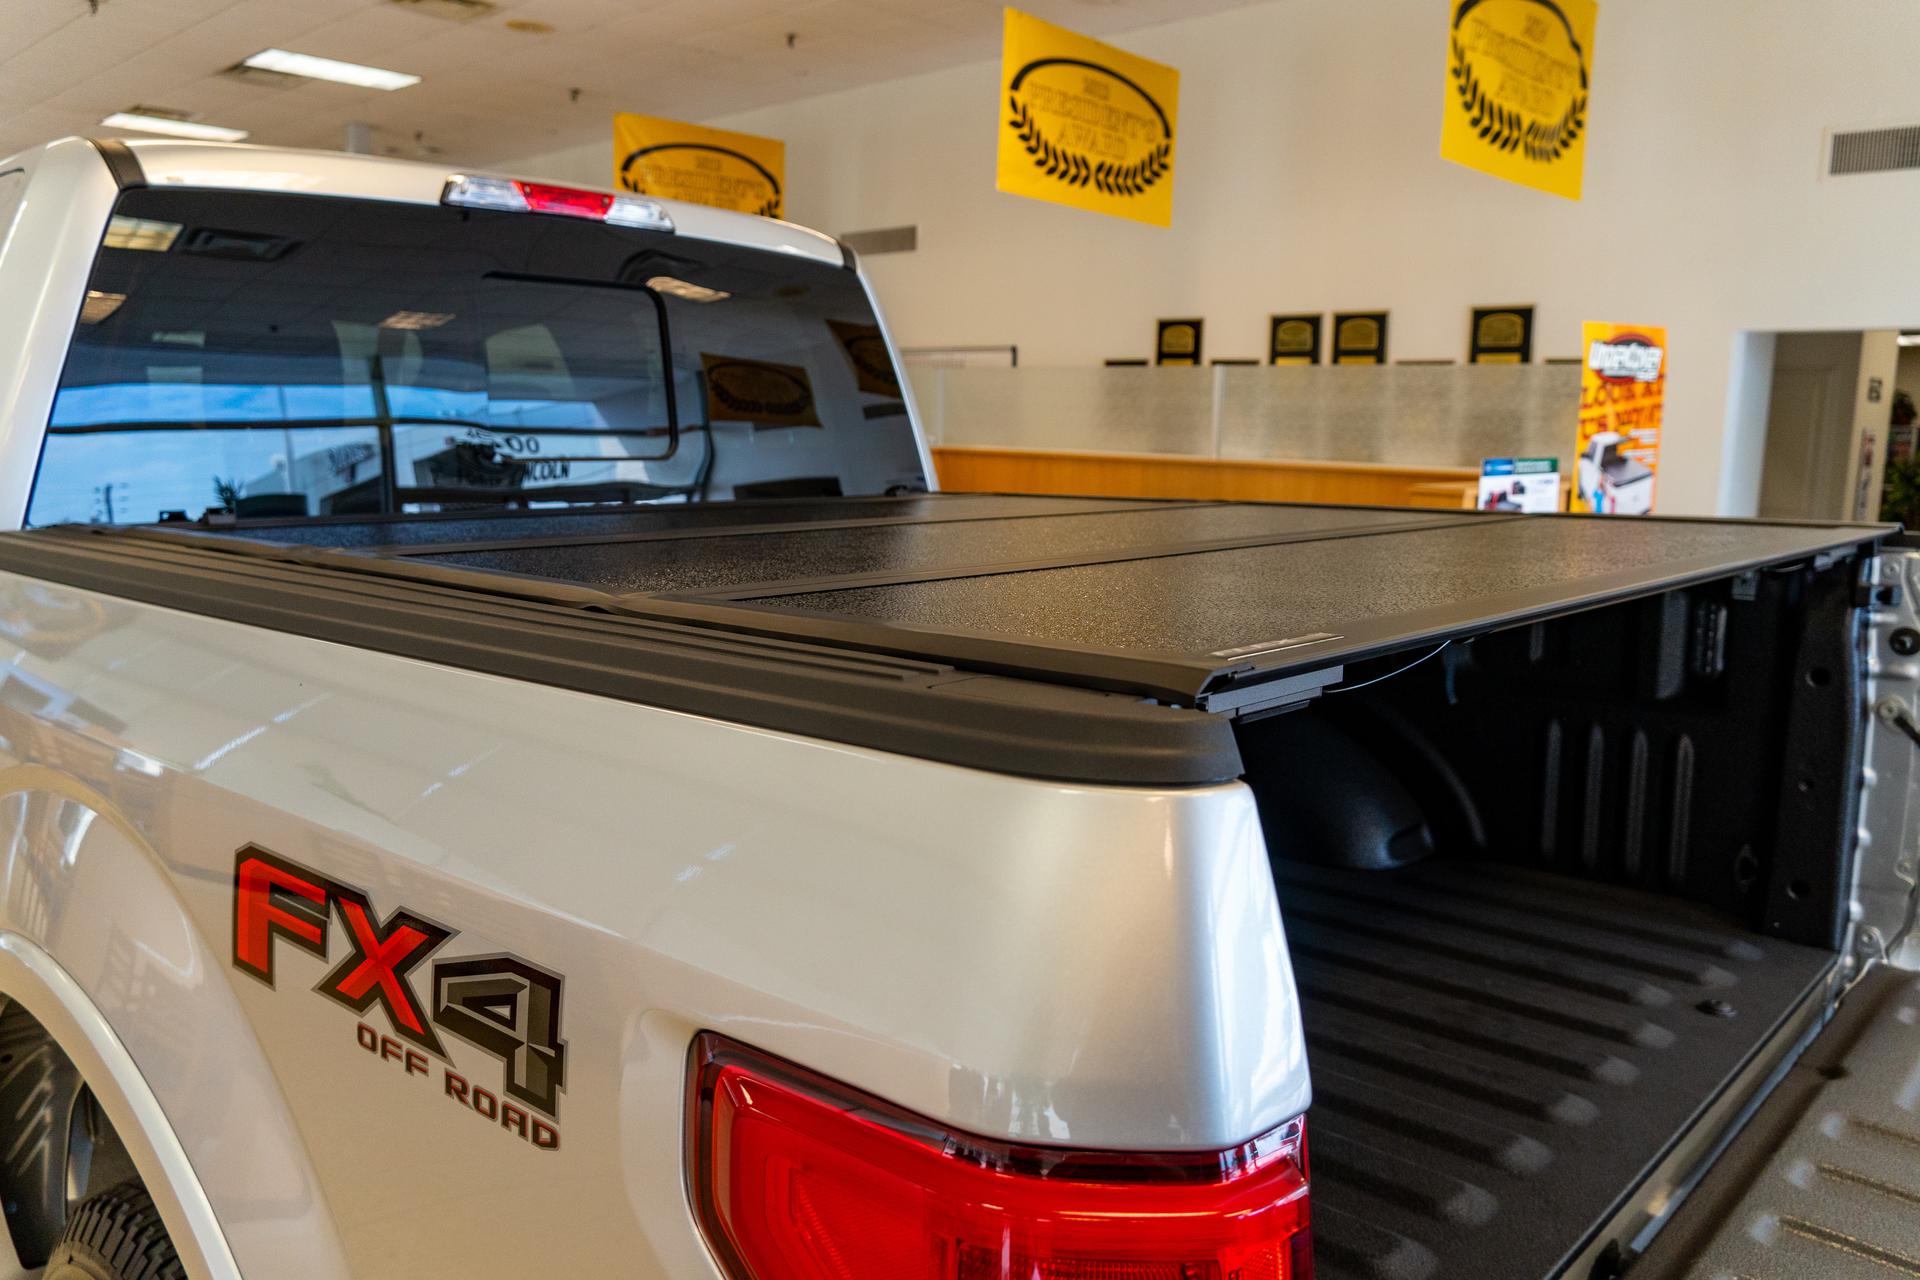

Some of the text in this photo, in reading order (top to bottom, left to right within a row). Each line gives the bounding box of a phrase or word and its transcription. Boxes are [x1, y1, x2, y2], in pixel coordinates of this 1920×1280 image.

[233, 842, 568, 1124] FX4
[357, 1021, 560, 1151] OFF ROAD
